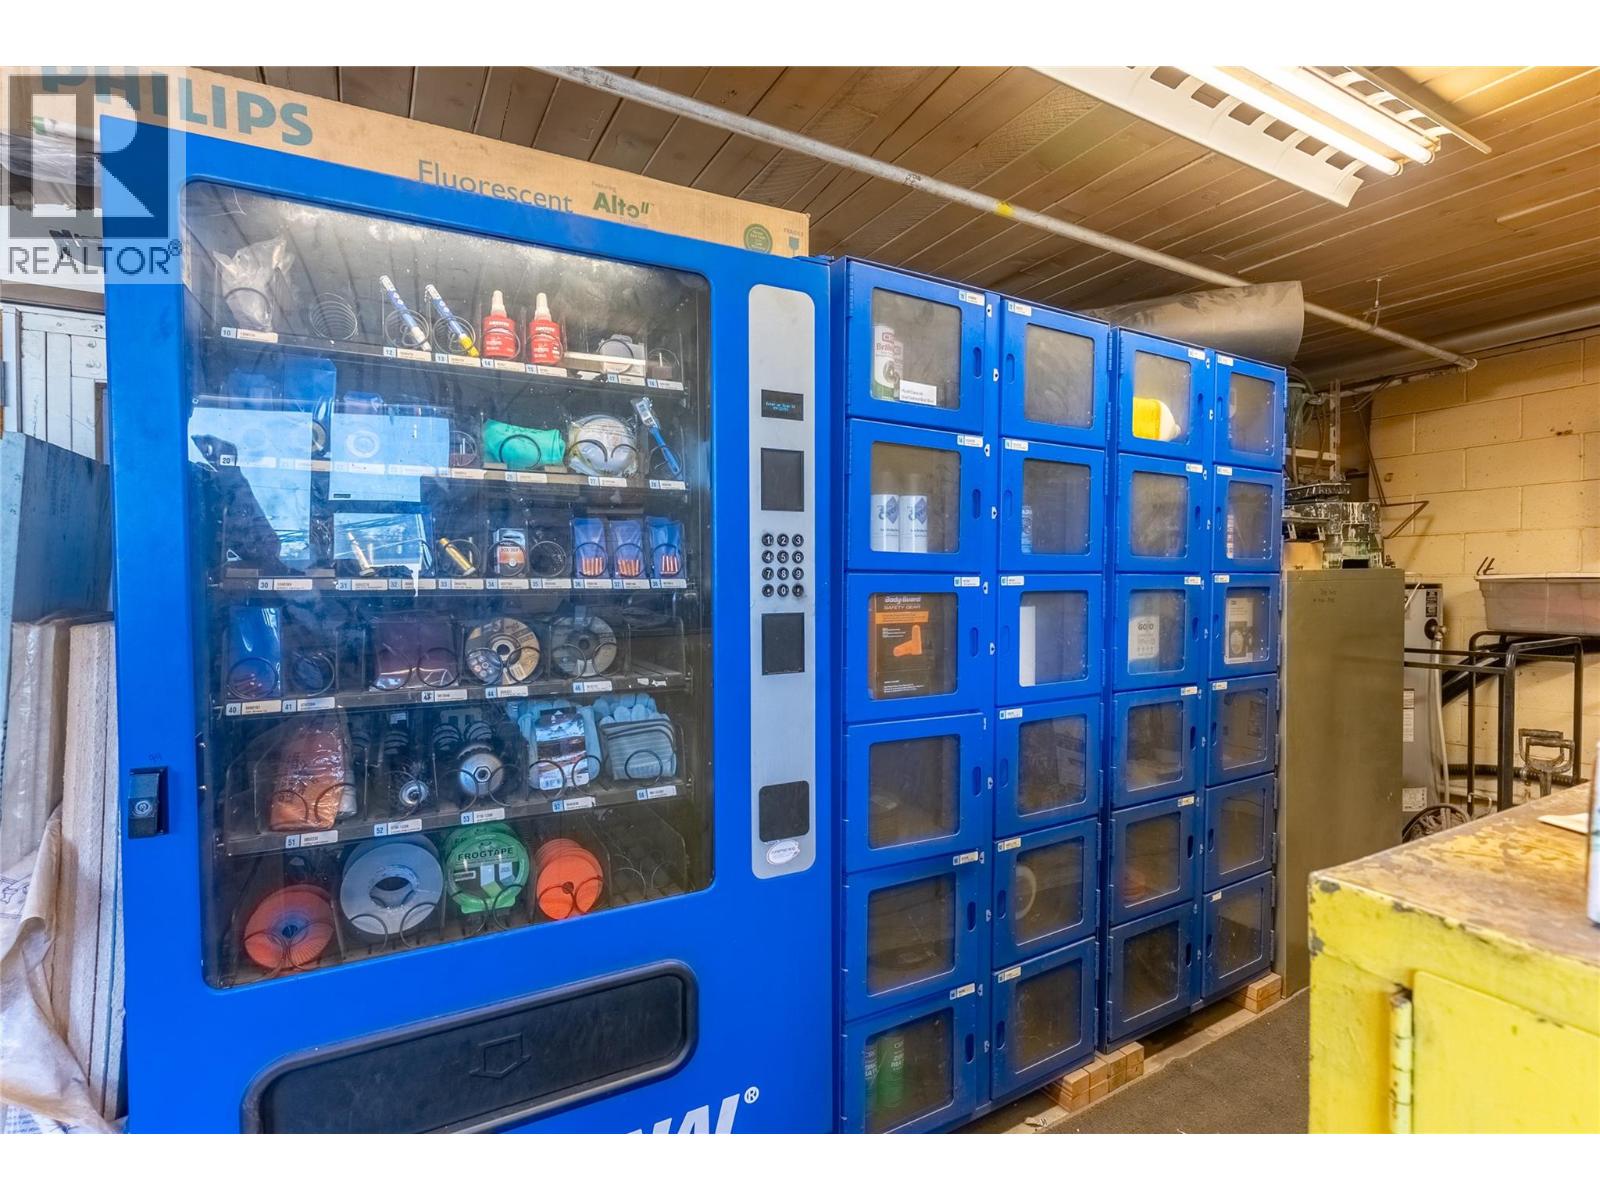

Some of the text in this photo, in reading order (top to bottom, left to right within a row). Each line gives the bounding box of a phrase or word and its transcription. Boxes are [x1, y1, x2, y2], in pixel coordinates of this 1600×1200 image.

[40, 66, 313, 146] PHILIPS
[418, 159, 574, 213] Fluorescent
[457, 847, 513, 861] FROGTAPE
